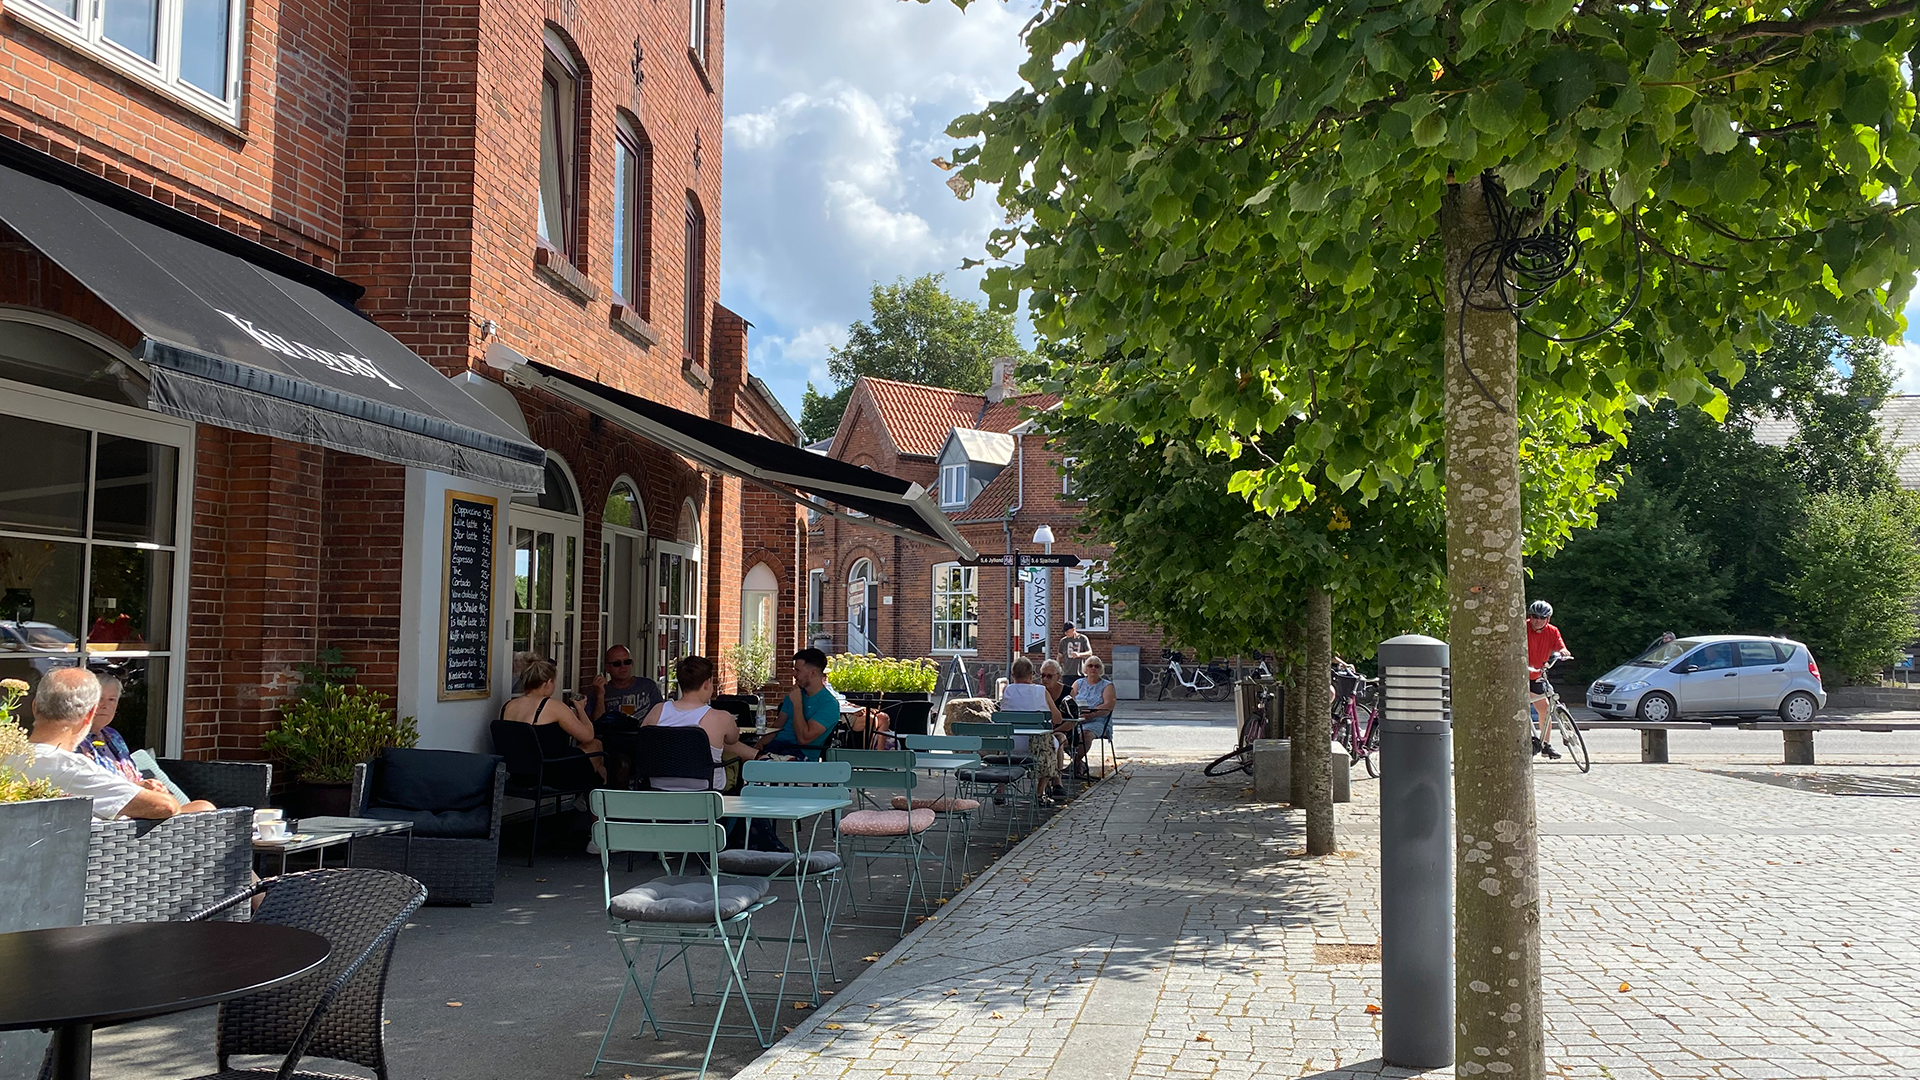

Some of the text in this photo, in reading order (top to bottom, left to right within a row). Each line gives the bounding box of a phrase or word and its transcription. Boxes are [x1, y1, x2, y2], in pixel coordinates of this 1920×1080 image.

[454, 504, 481, 518] Cappuccino
[466, 519, 478, 529] latte
[466, 531, 478, 541] latte
[453, 542, 476, 553] Americano
[452, 553, 473, 565] Espresso
[452, 566, 462, 576] The
[452, 577, 471, 587] Cortado
[1034, 577, 1046, 626] SAMSØ
